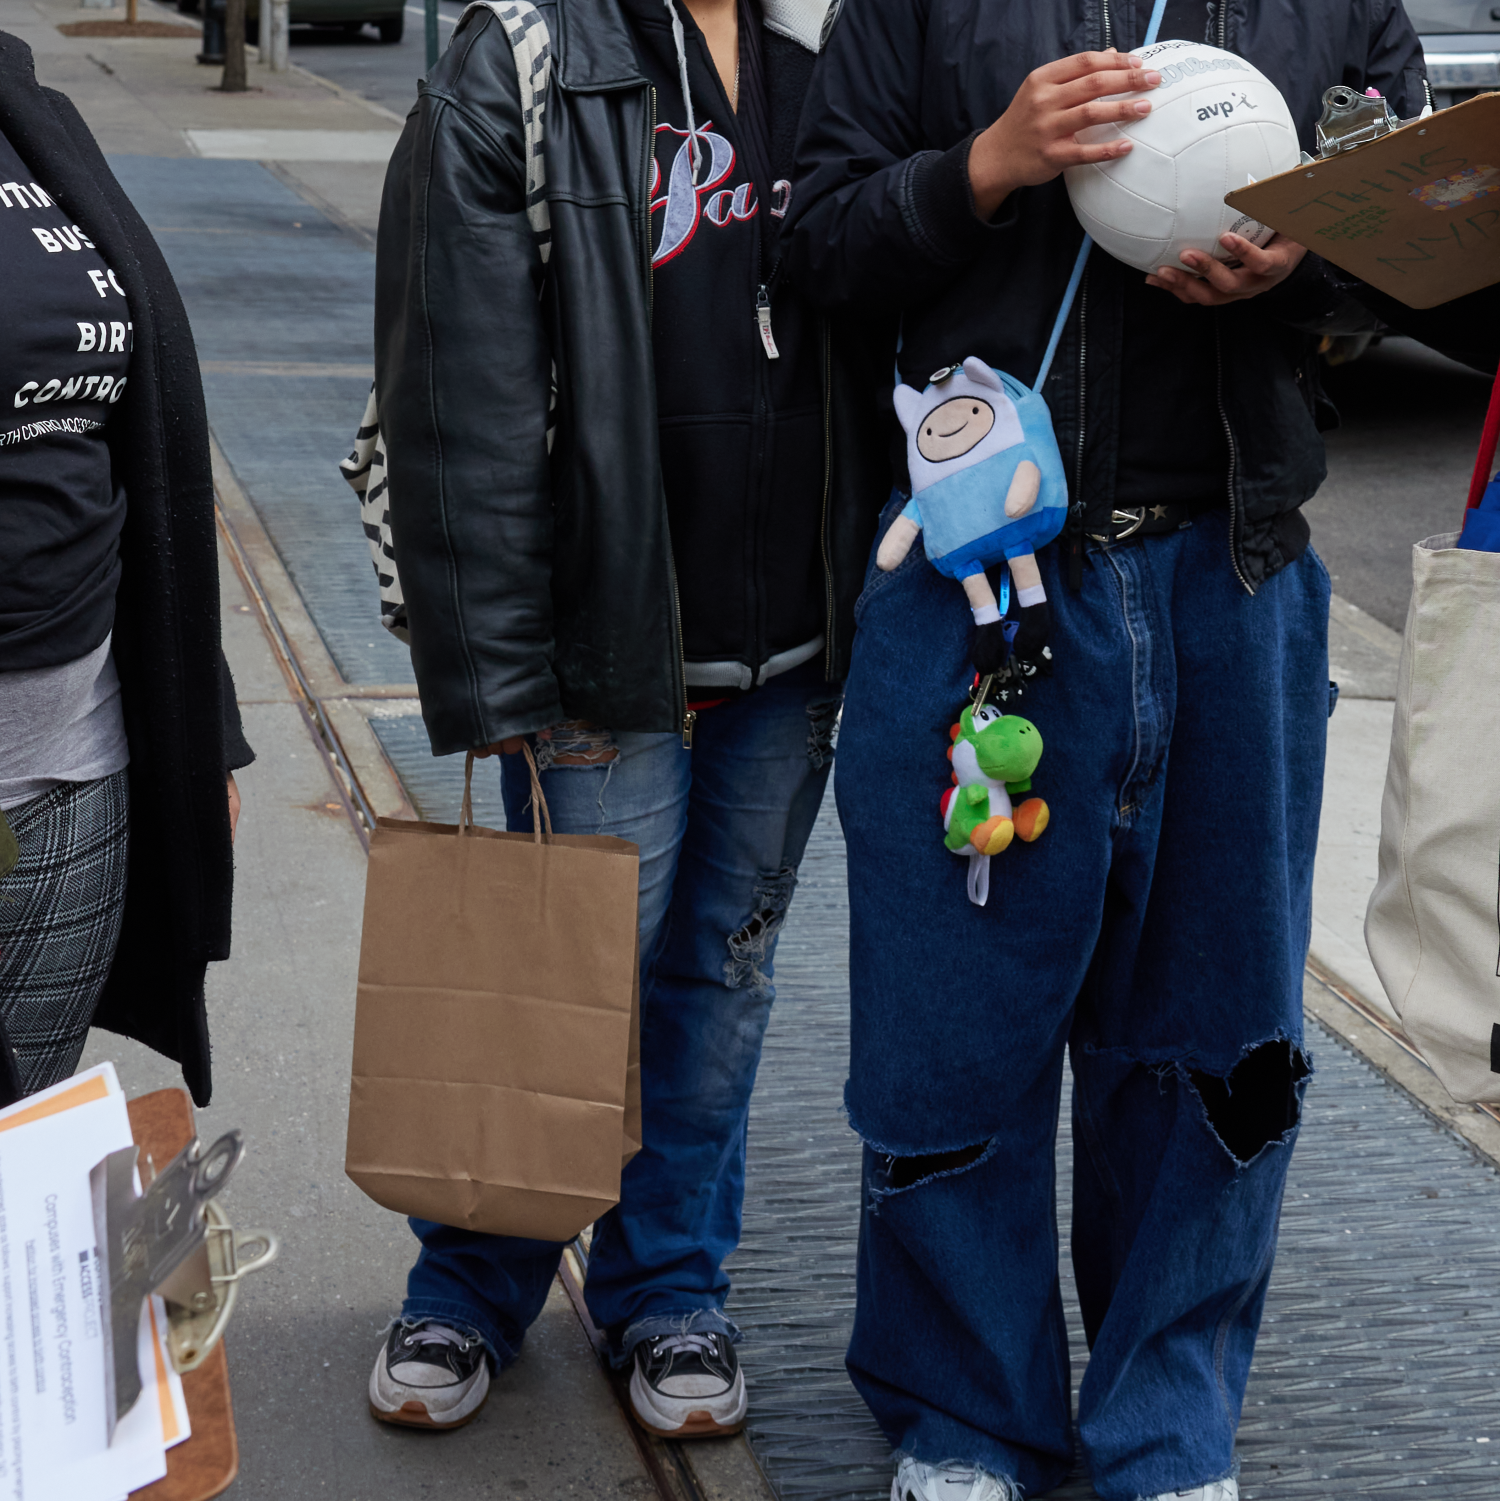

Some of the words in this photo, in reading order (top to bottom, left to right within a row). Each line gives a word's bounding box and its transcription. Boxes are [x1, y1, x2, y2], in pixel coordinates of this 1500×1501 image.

[1158, 57, 1249, 89] Wilson
[1196, 100, 1234, 121] avp
[42, 1192, 60, 1253] Campuses
[51, 1253, 63, 1276] with
[80, 1263, 92, 1298] ACCESS
[48, 1276, 68, 1340] Emergency
[83, 1296, 96, 1340] PROJECT
[55, 1338, 77, 1426] Contraception
